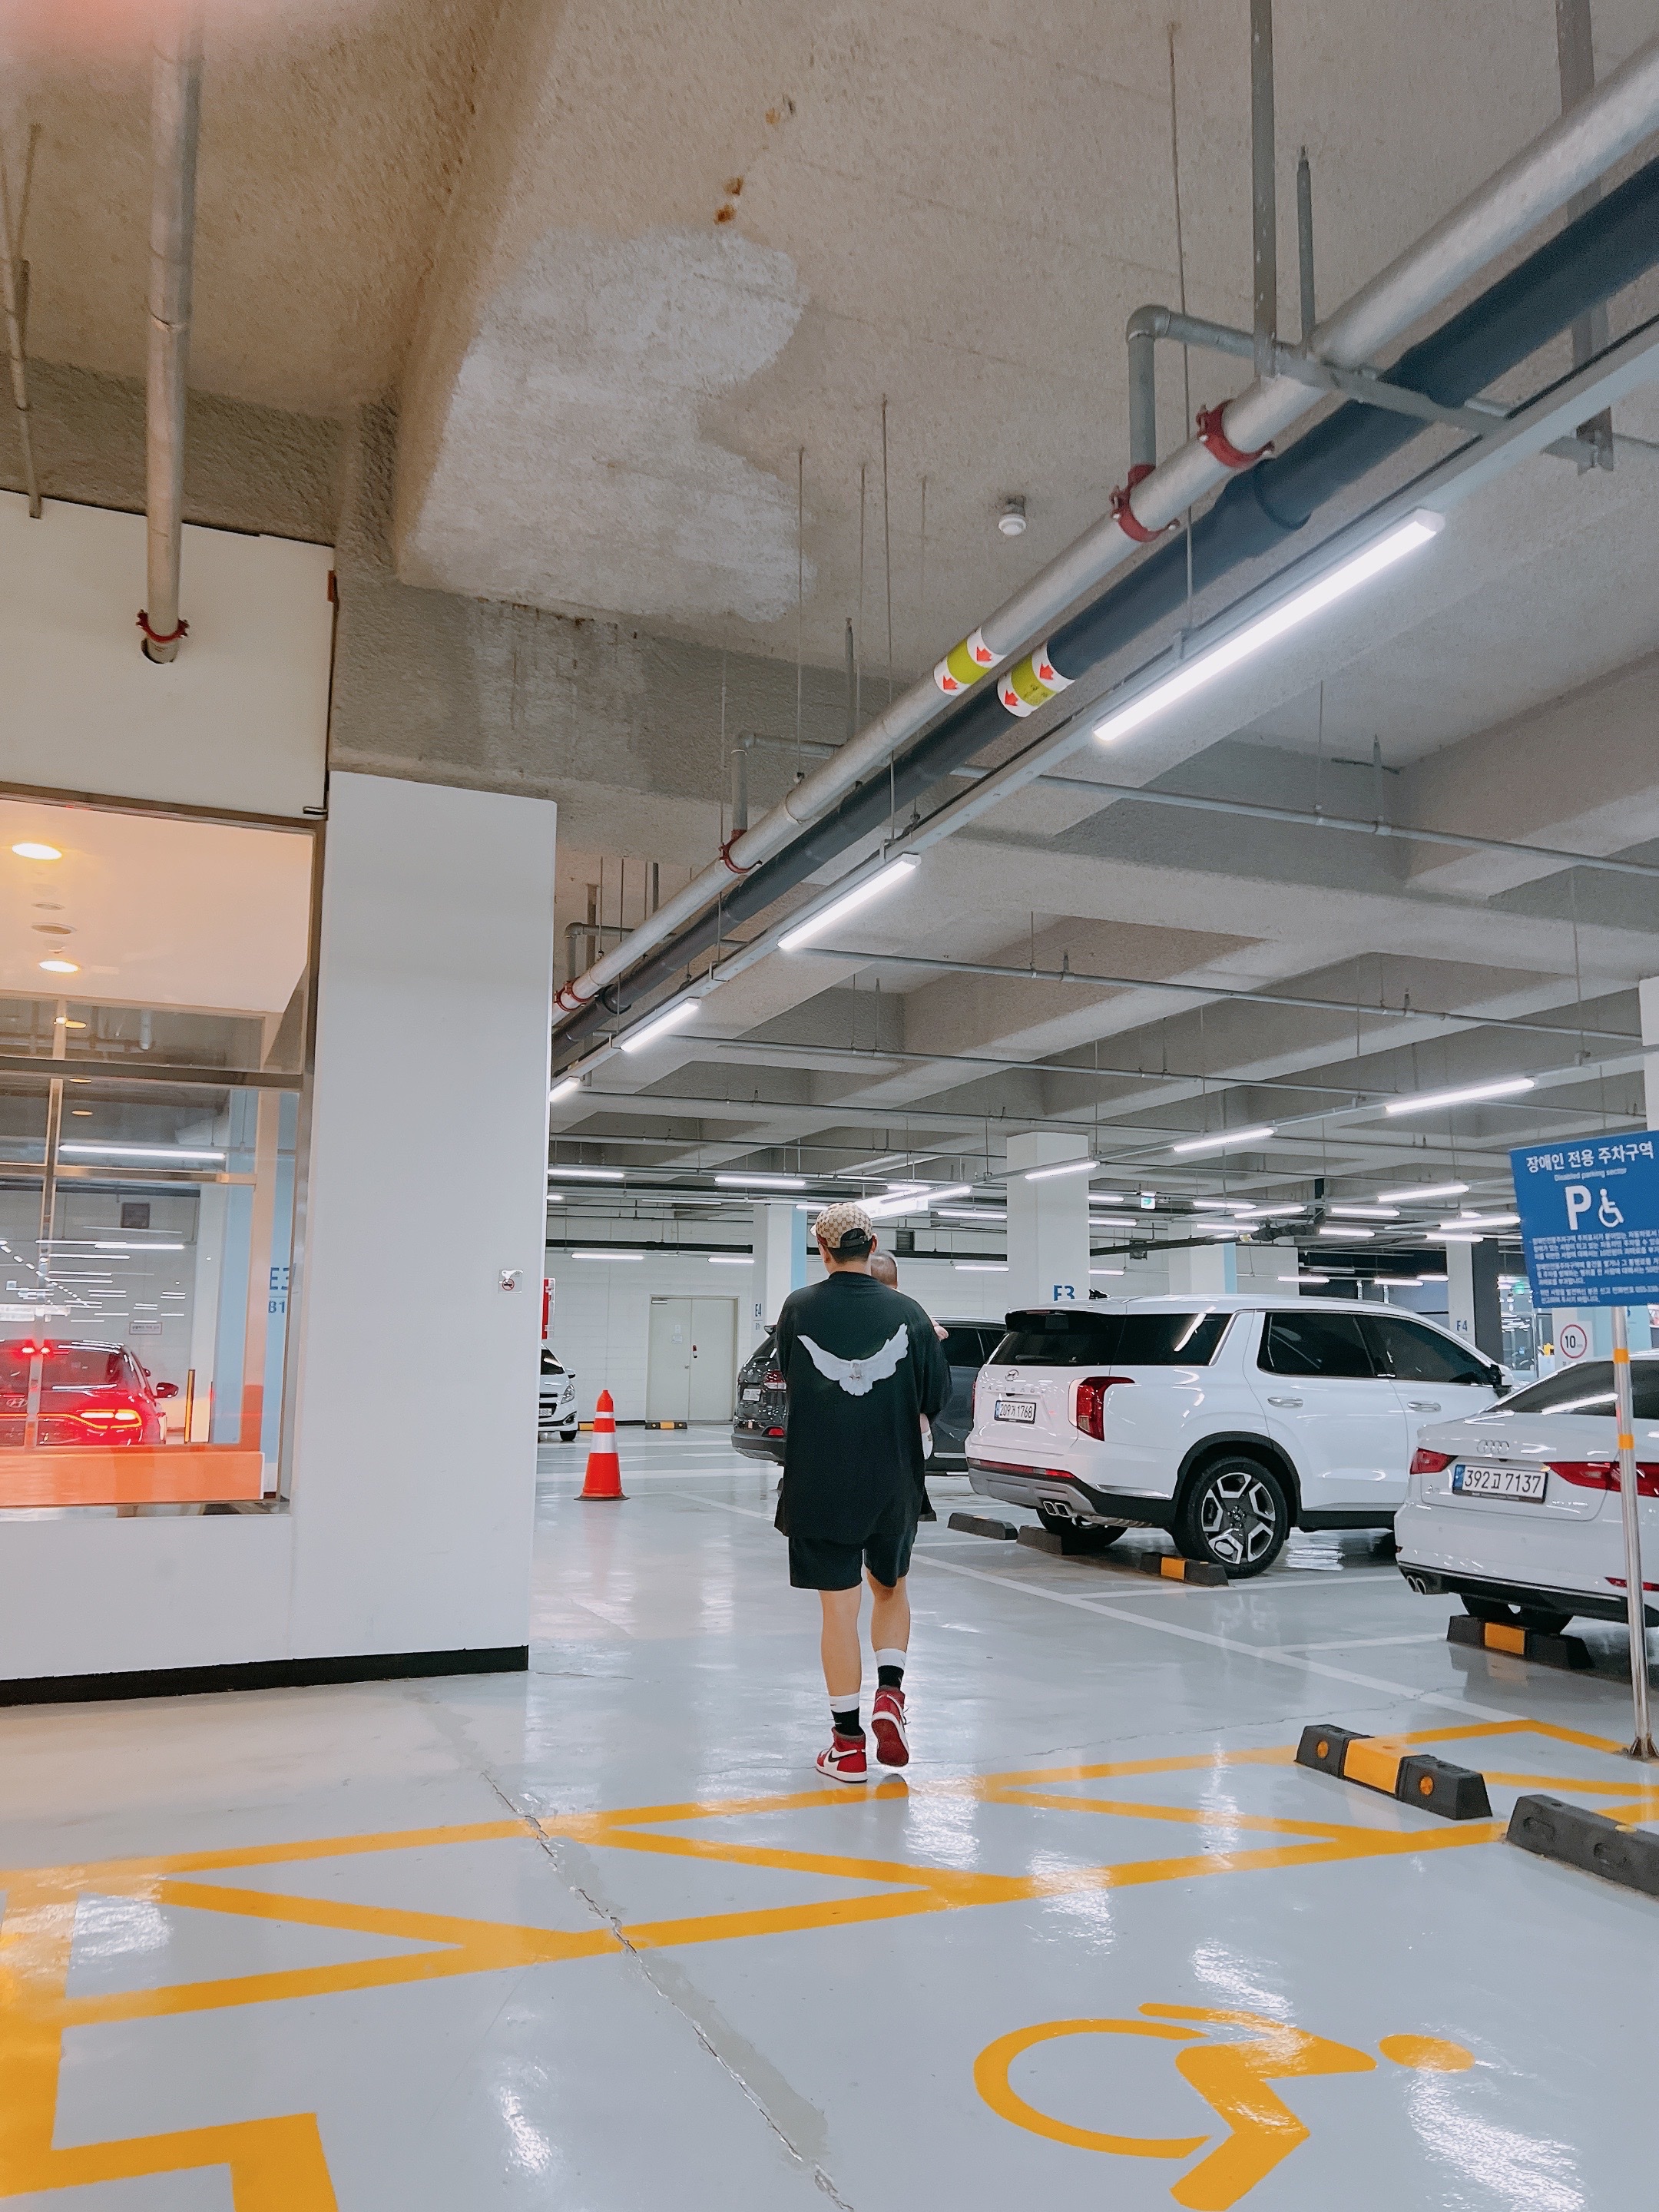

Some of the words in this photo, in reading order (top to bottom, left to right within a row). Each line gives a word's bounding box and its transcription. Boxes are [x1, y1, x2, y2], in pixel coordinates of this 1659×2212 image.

[1526, 1153, 1565, 1173] 장애인
[1568, 1149, 1594, 1168] 전용
[1598, 1141, 1654, 1164] 주차구역
[1565, 1185, 1592, 1230] P
[1054, 1285, 1075, 1301] F3
[268, 1301, 285, 1313] B1
[1456, 1320, 1467, 1331] F4
[1565, 1335, 1576, 1348] 10
[1464, 1469, 1502, 1489] 392고
[1505, 1473, 1541, 1494] 7137
